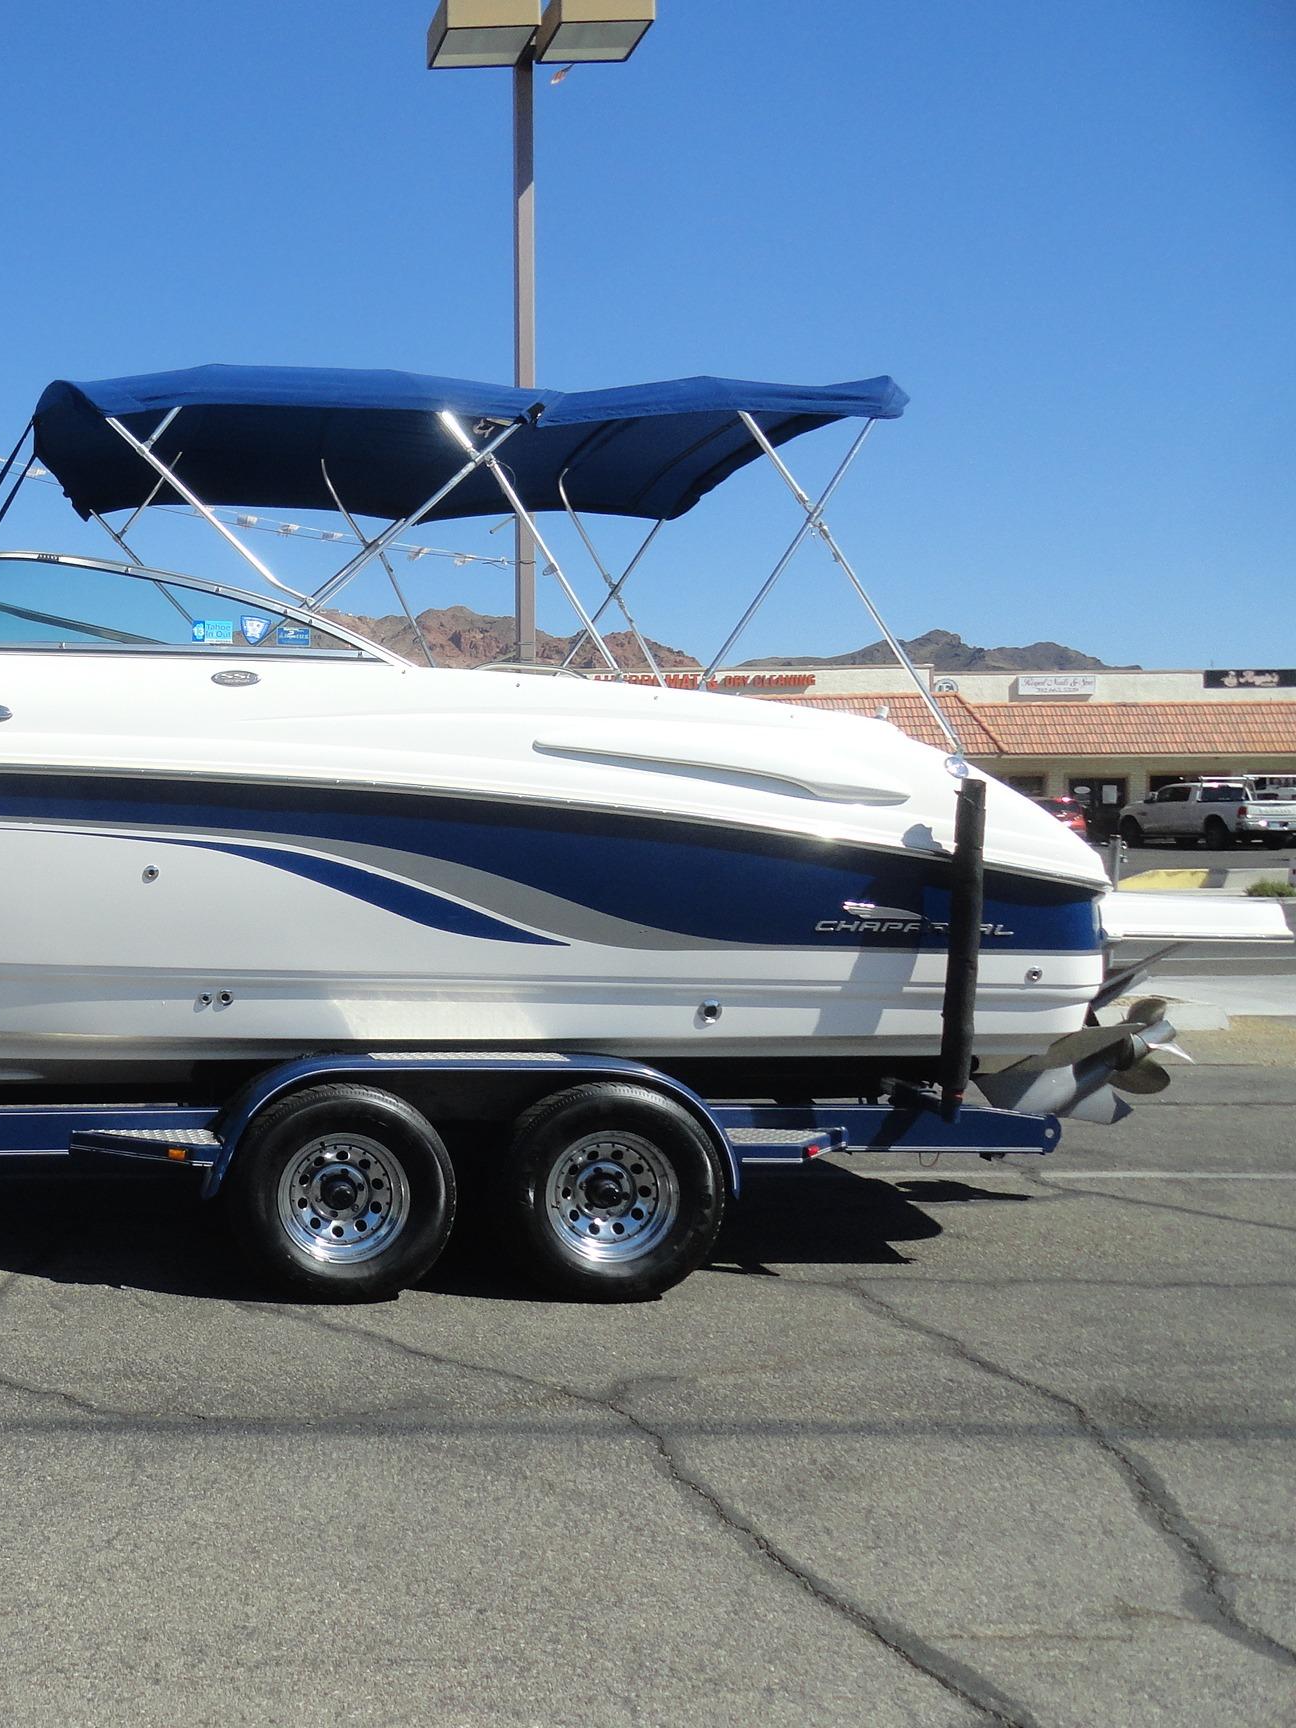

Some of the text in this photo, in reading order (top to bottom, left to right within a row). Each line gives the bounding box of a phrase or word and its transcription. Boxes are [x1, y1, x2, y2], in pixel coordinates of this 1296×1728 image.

[724, 674, 750, 688] DRY
[751, 673, 816, 688] CLEANING
[814, 919, 1015, 936] CHAPARAL
